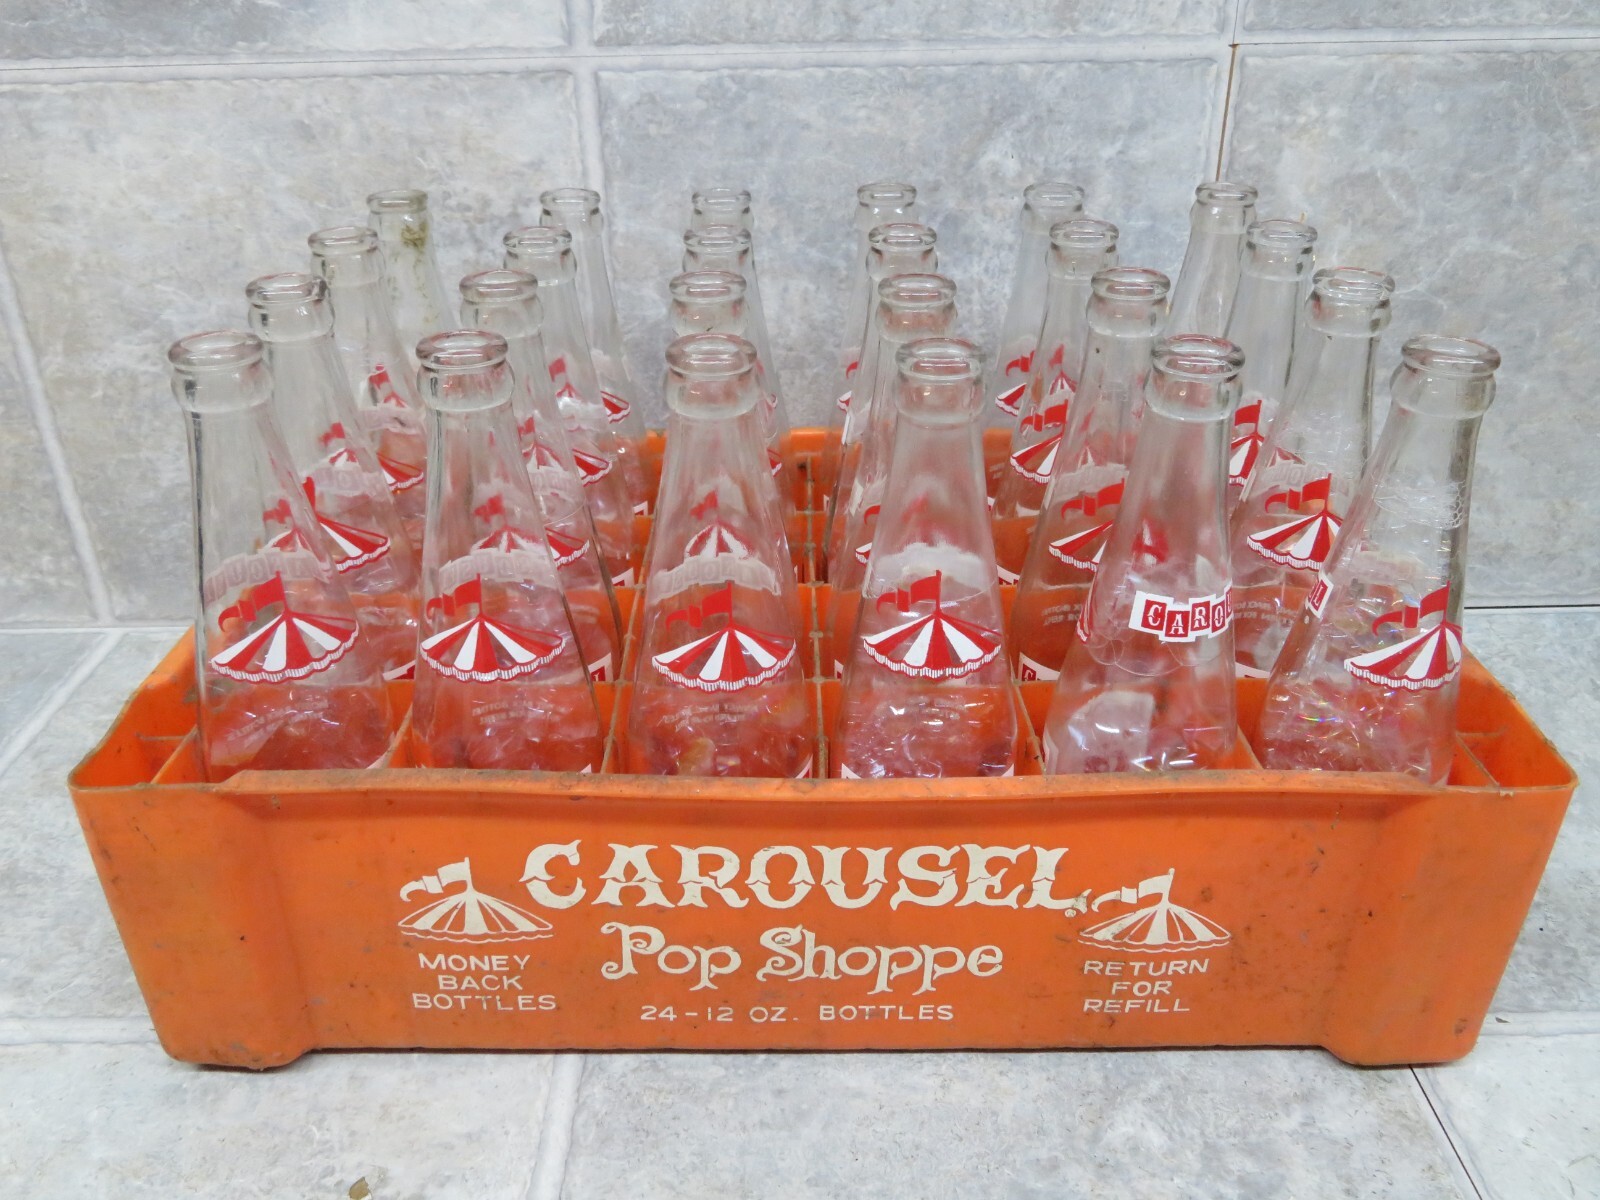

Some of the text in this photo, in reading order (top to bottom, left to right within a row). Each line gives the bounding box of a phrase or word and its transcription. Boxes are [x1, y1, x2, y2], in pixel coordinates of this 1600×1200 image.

[519, 839, 1091, 914] CAROUSEL
[418, 952, 531, 972] MONEY
[600, 921, 1004, 996] Pop Shoppe
[1083, 958, 1211, 977] RETURN
[437, 974, 523, 992] BACK
[1111, 980, 1174, 997] FOR
[411, 992, 557, 1011] BOTTLES
[1083, 998, 1191, 1014] REFILL
[749, 1006, 799, 1022] OZ.
[819, 1004, 955, 1021] BOTTLES
